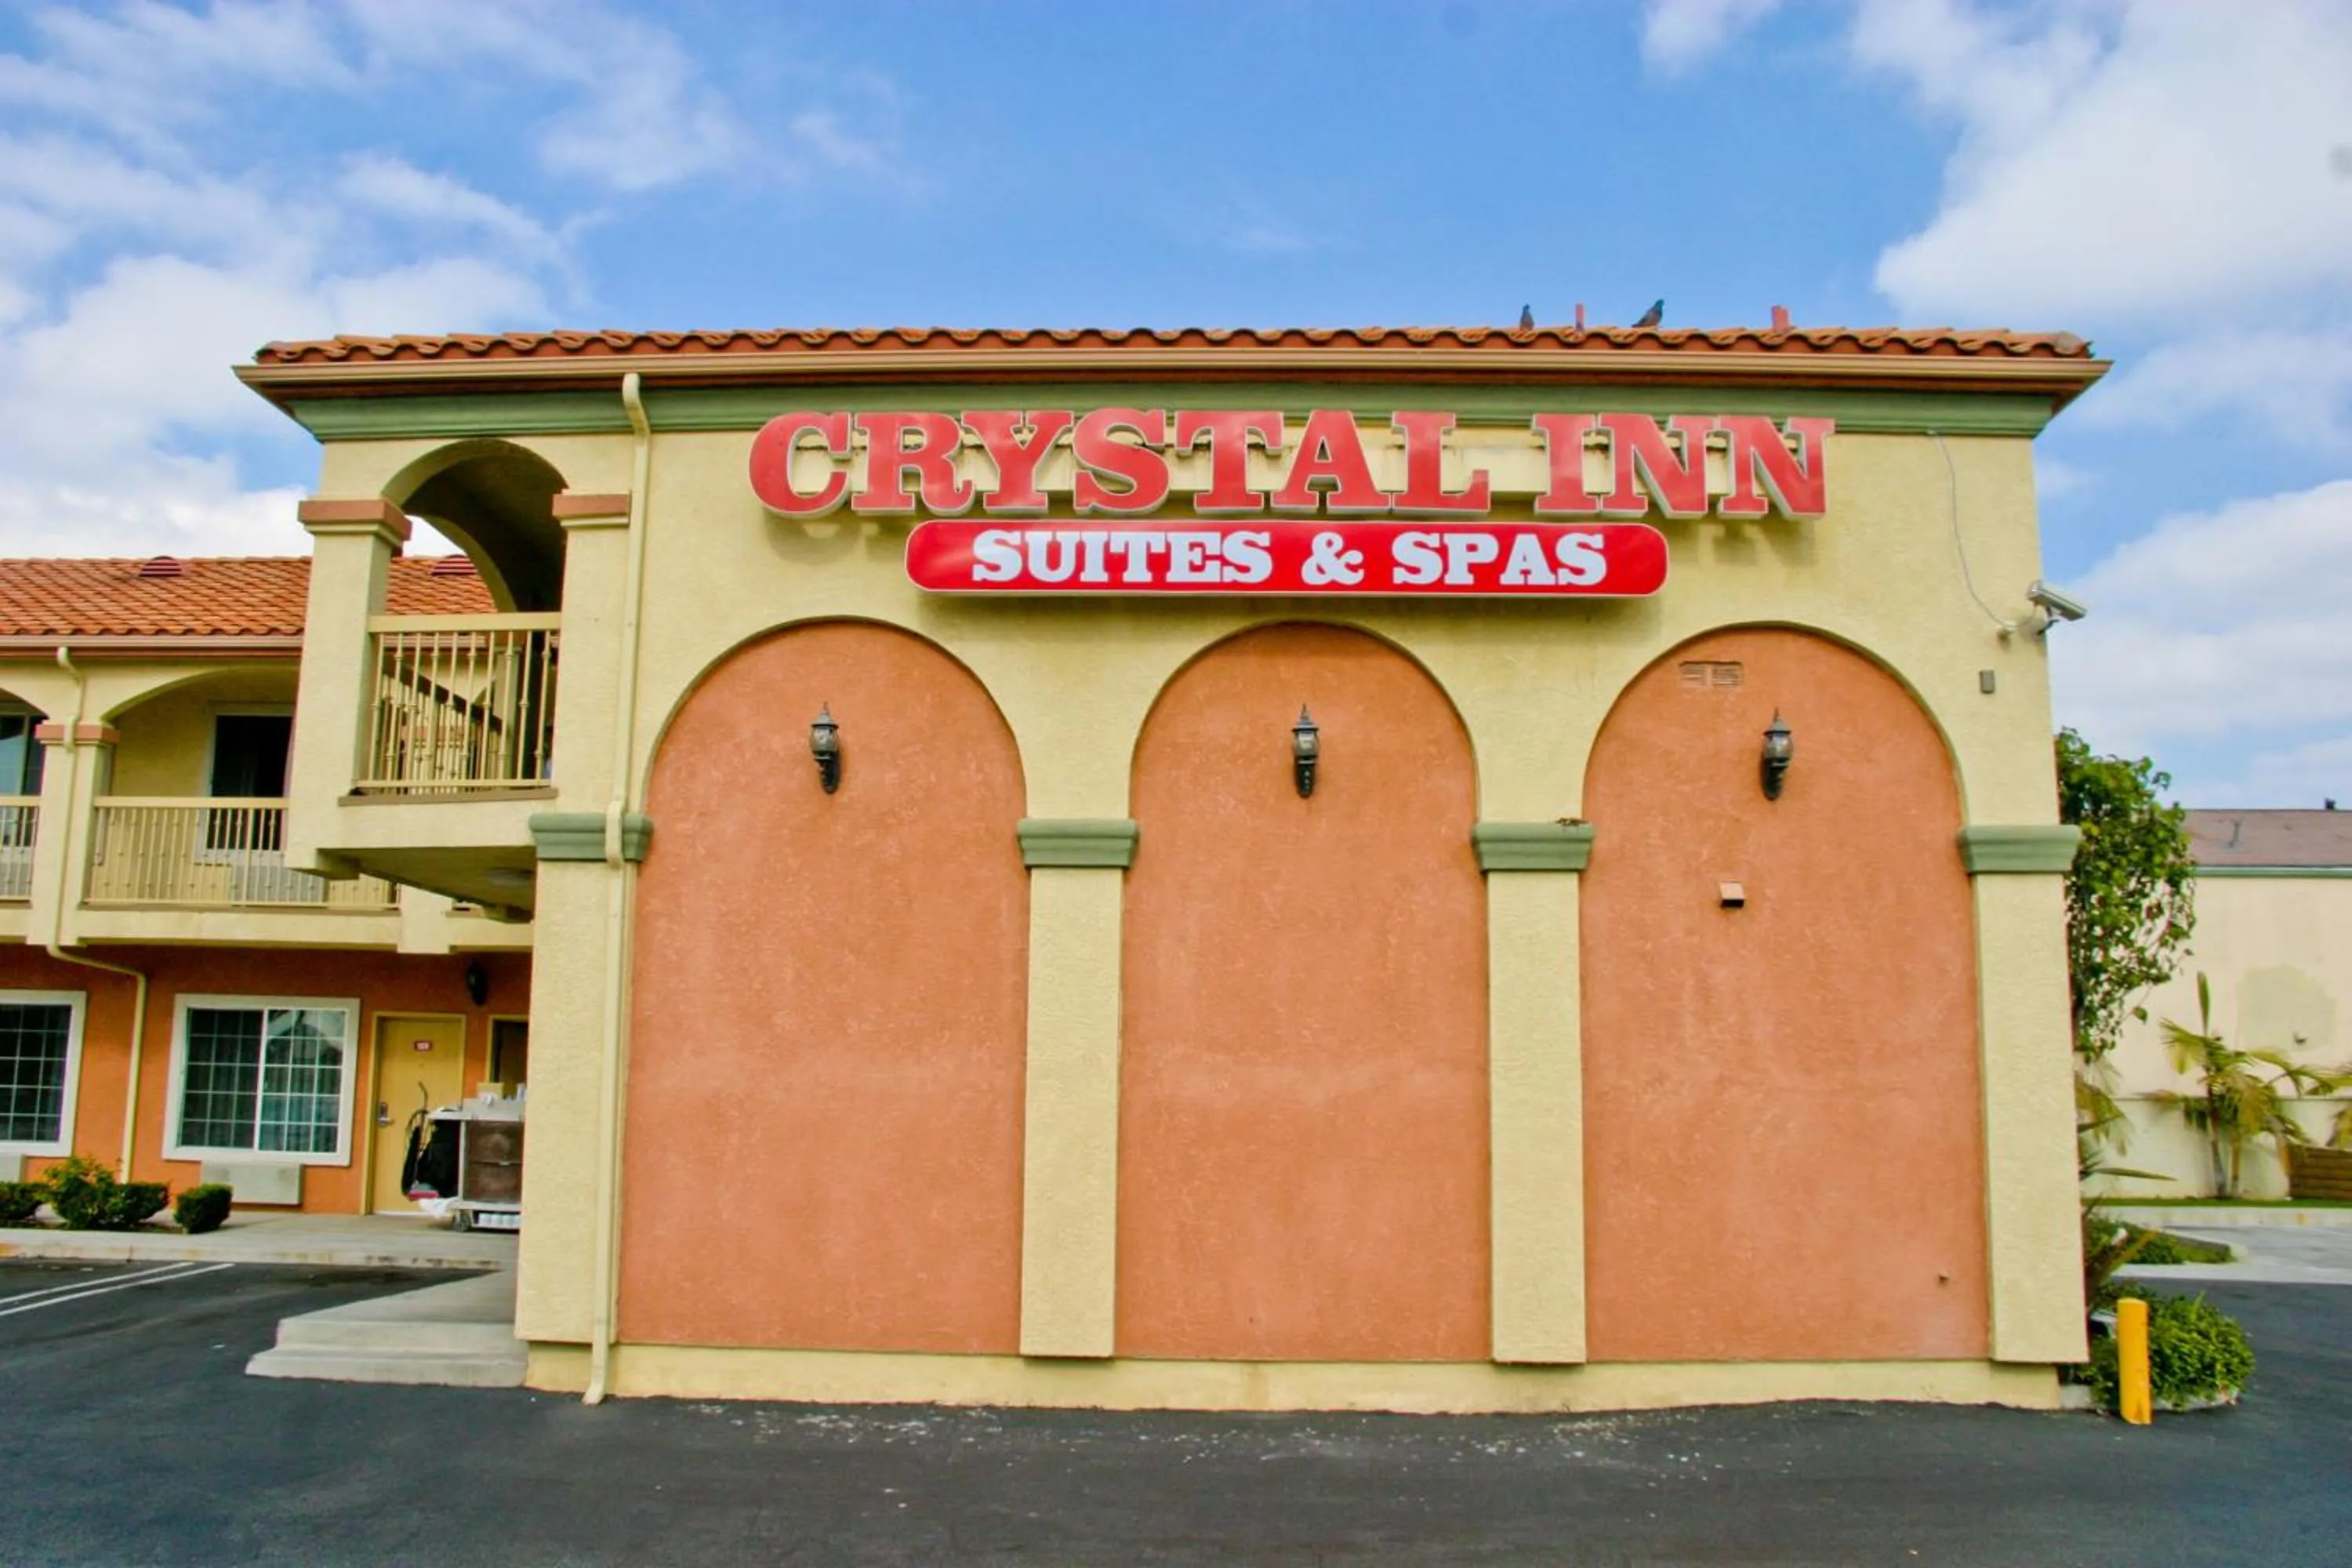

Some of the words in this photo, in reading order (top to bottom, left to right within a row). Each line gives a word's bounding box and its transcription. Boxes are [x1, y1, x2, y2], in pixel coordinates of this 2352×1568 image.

[749, 408, 1490, 517] CRYSTAL
[1531, 412, 1835, 519] INN
[972, 529, 1272, 583] SUITES
[1301, 532, 1364, 585] &
[1392, 532, 1607, 586] SPAS
